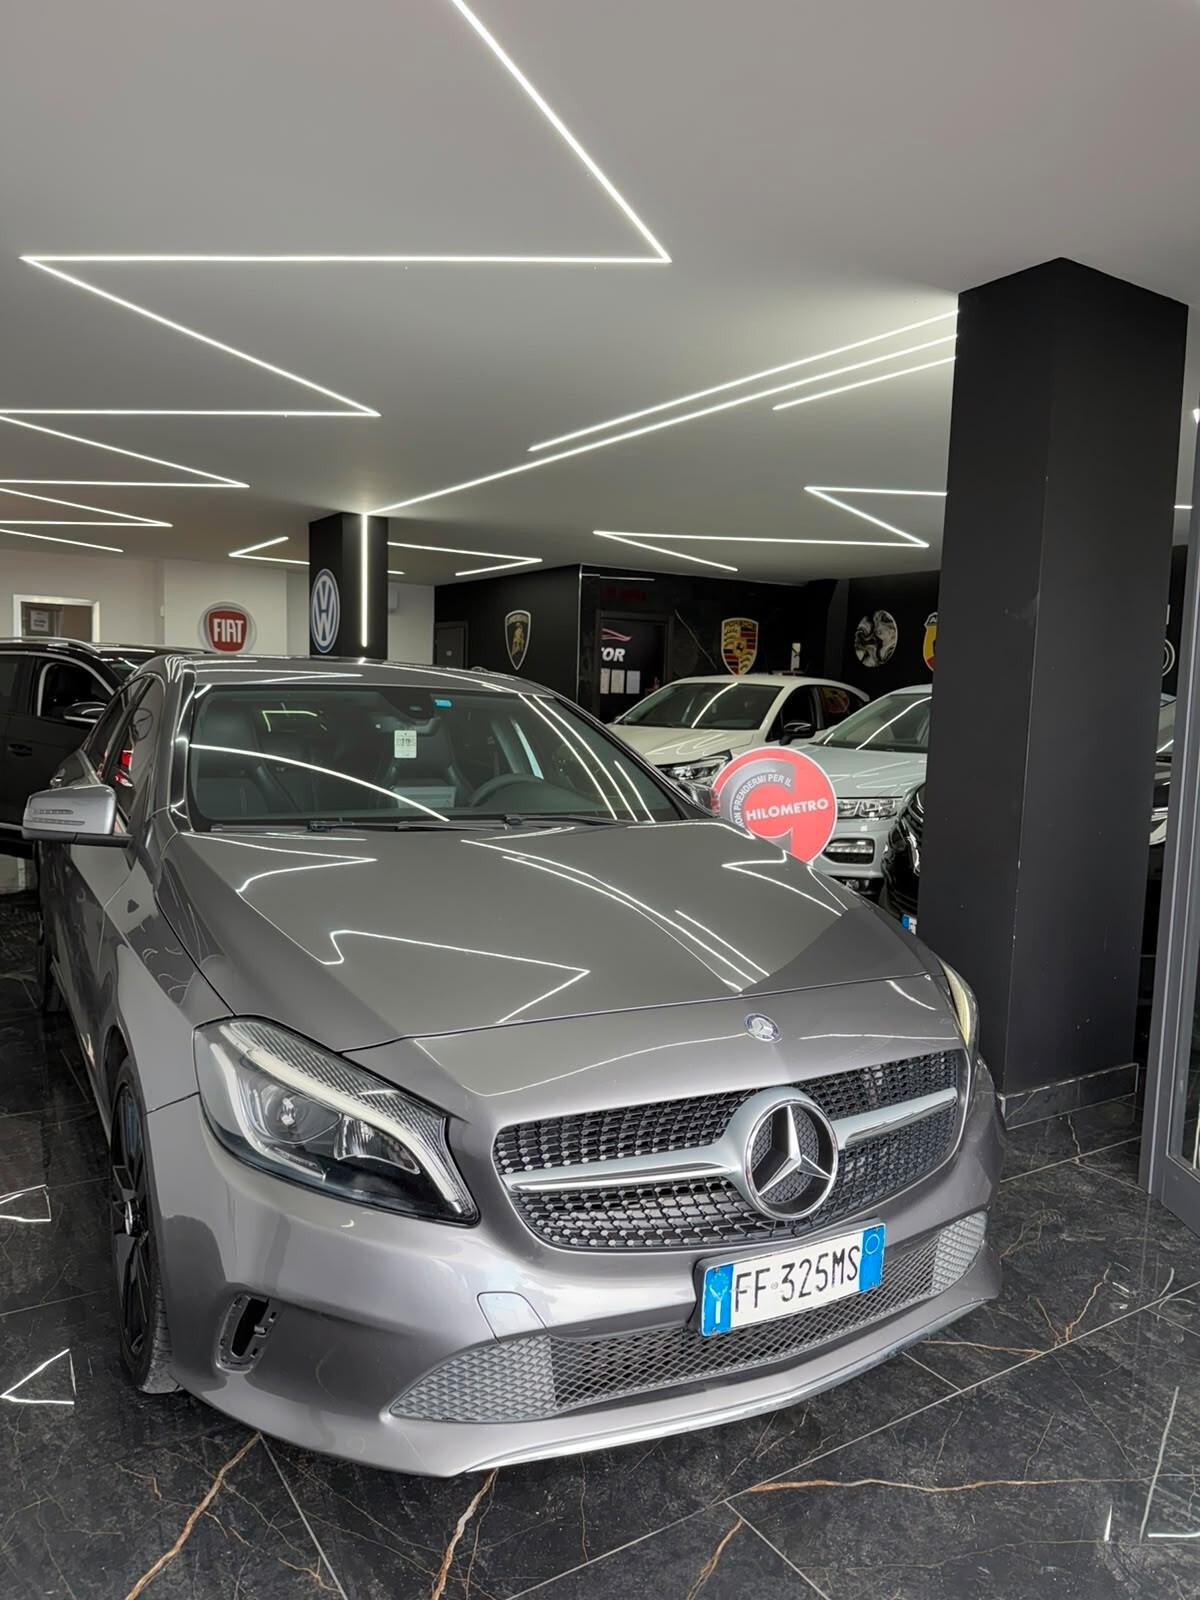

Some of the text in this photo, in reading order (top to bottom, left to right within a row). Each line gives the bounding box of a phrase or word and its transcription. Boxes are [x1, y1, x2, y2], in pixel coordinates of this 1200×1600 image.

[213, 618, 244, 643] FIAT
[601, 647, 626, 662] OR
[767, 773, 785, 784] PER
[784, 777, 792, 788] IL
